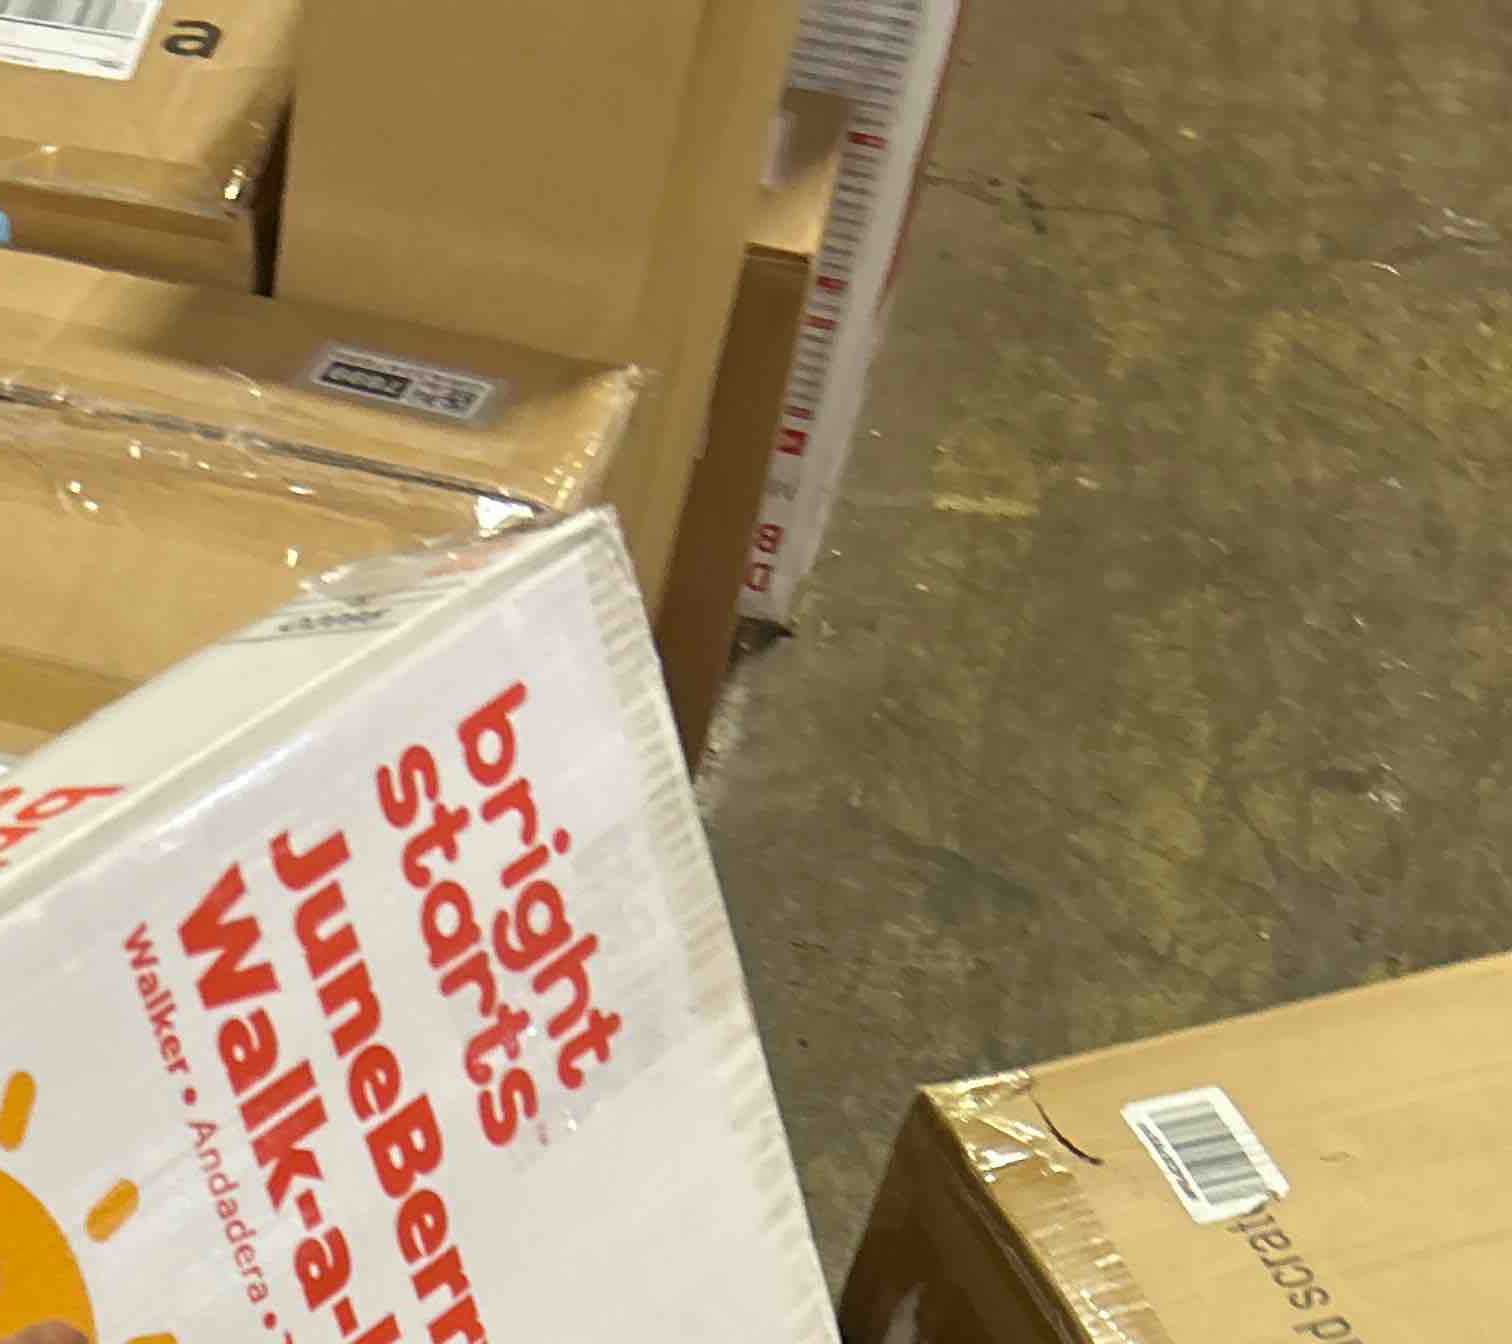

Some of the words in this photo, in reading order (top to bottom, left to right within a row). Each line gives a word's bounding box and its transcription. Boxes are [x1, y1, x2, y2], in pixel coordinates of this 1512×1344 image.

[377, 744, 538, 1147] starts
[458, 680, 620, 1091] bright
[124, 922, 190, 1077] Walker
[188, 1119, 269, 1304] Andadera
[1226, 1192, 1331, 1314] scrat
